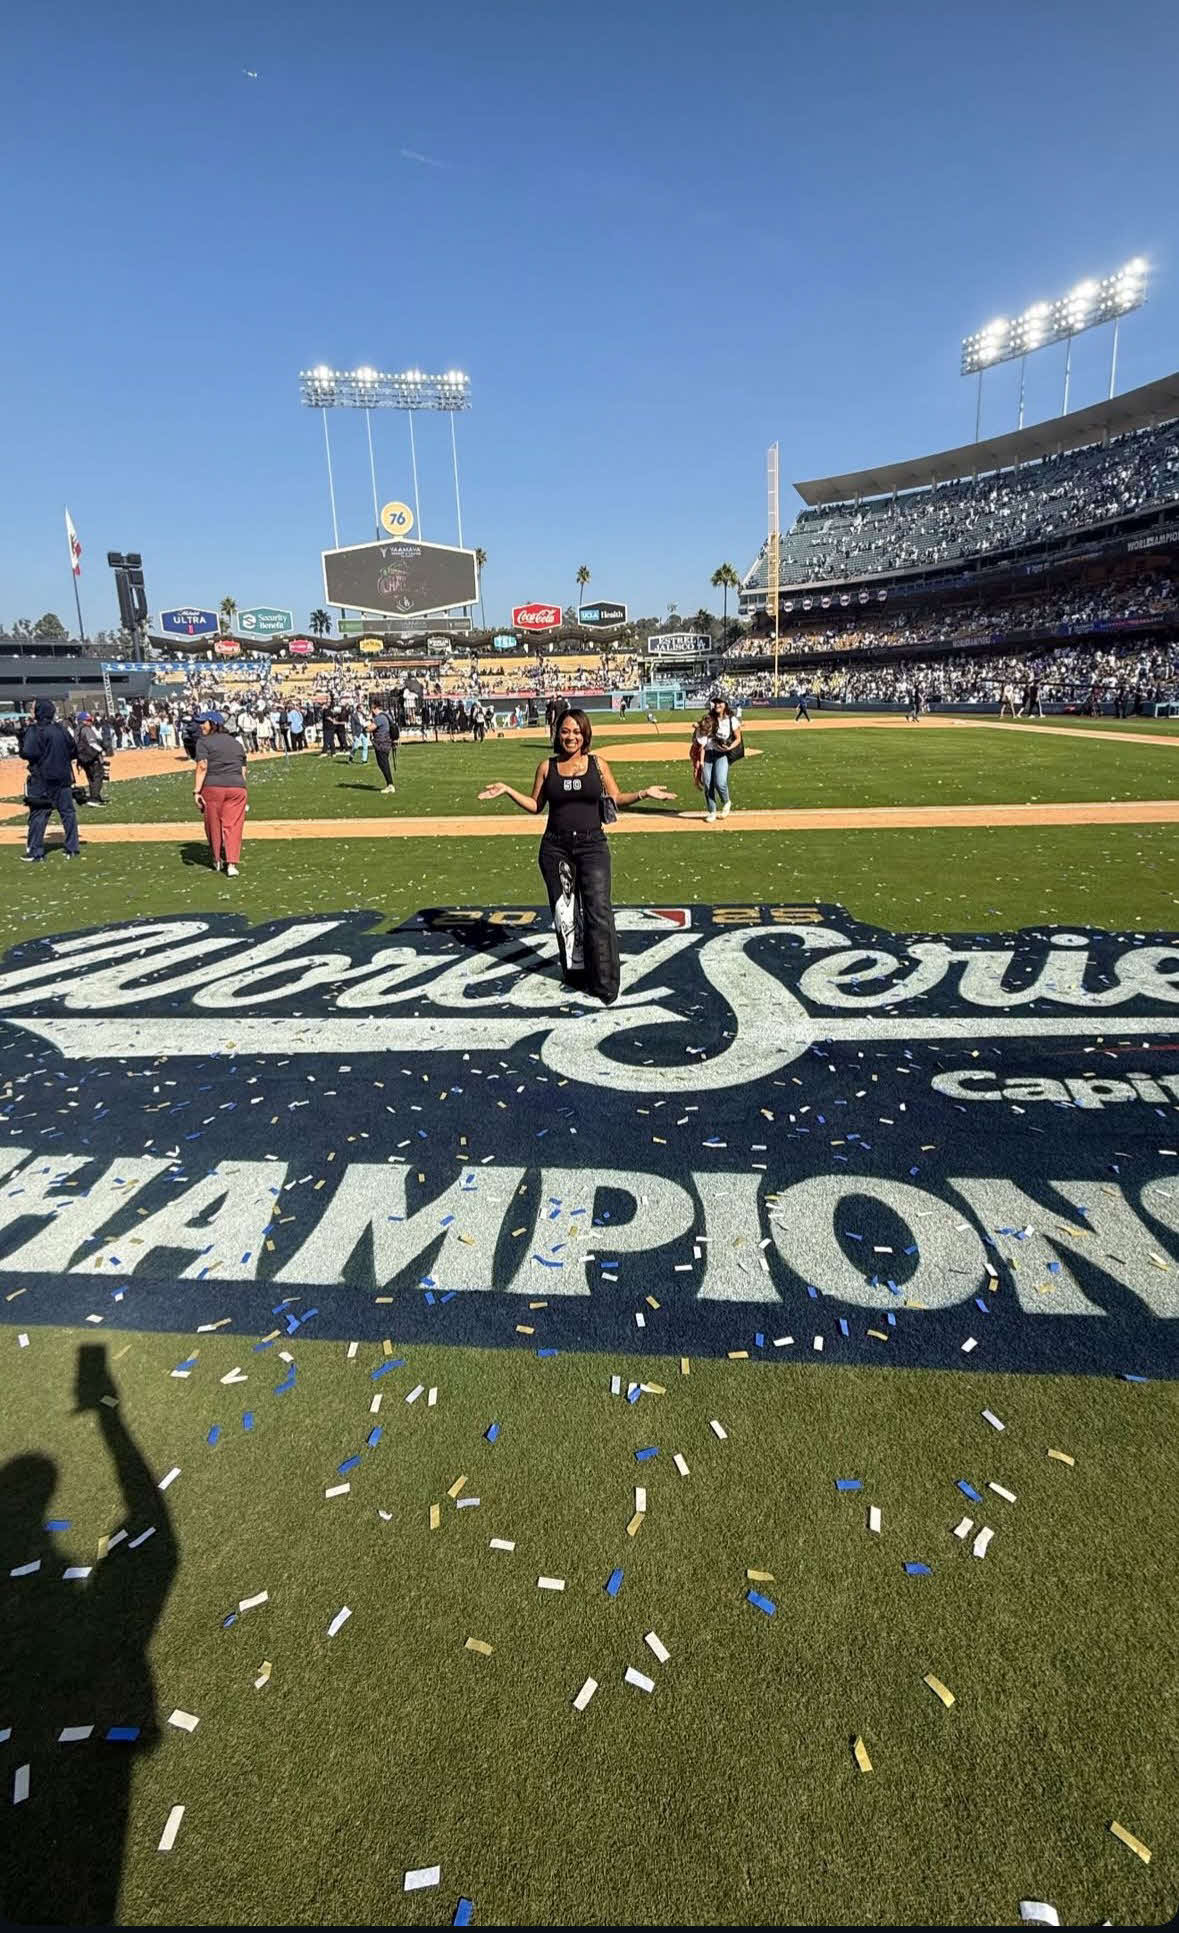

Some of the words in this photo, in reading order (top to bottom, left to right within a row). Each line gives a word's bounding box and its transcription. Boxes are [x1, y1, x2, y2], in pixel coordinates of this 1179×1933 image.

[389, 512, 406, 525] 76
[173, 616, 207, 624] ULTRA
[258, 614, 287, 622] Security
[600, 610, 624, 619] Health
[563, 779, 582, 791] 50
[711, 908, 824, 924] 25
[0, 1147, 1179, 1320] HAMPION
